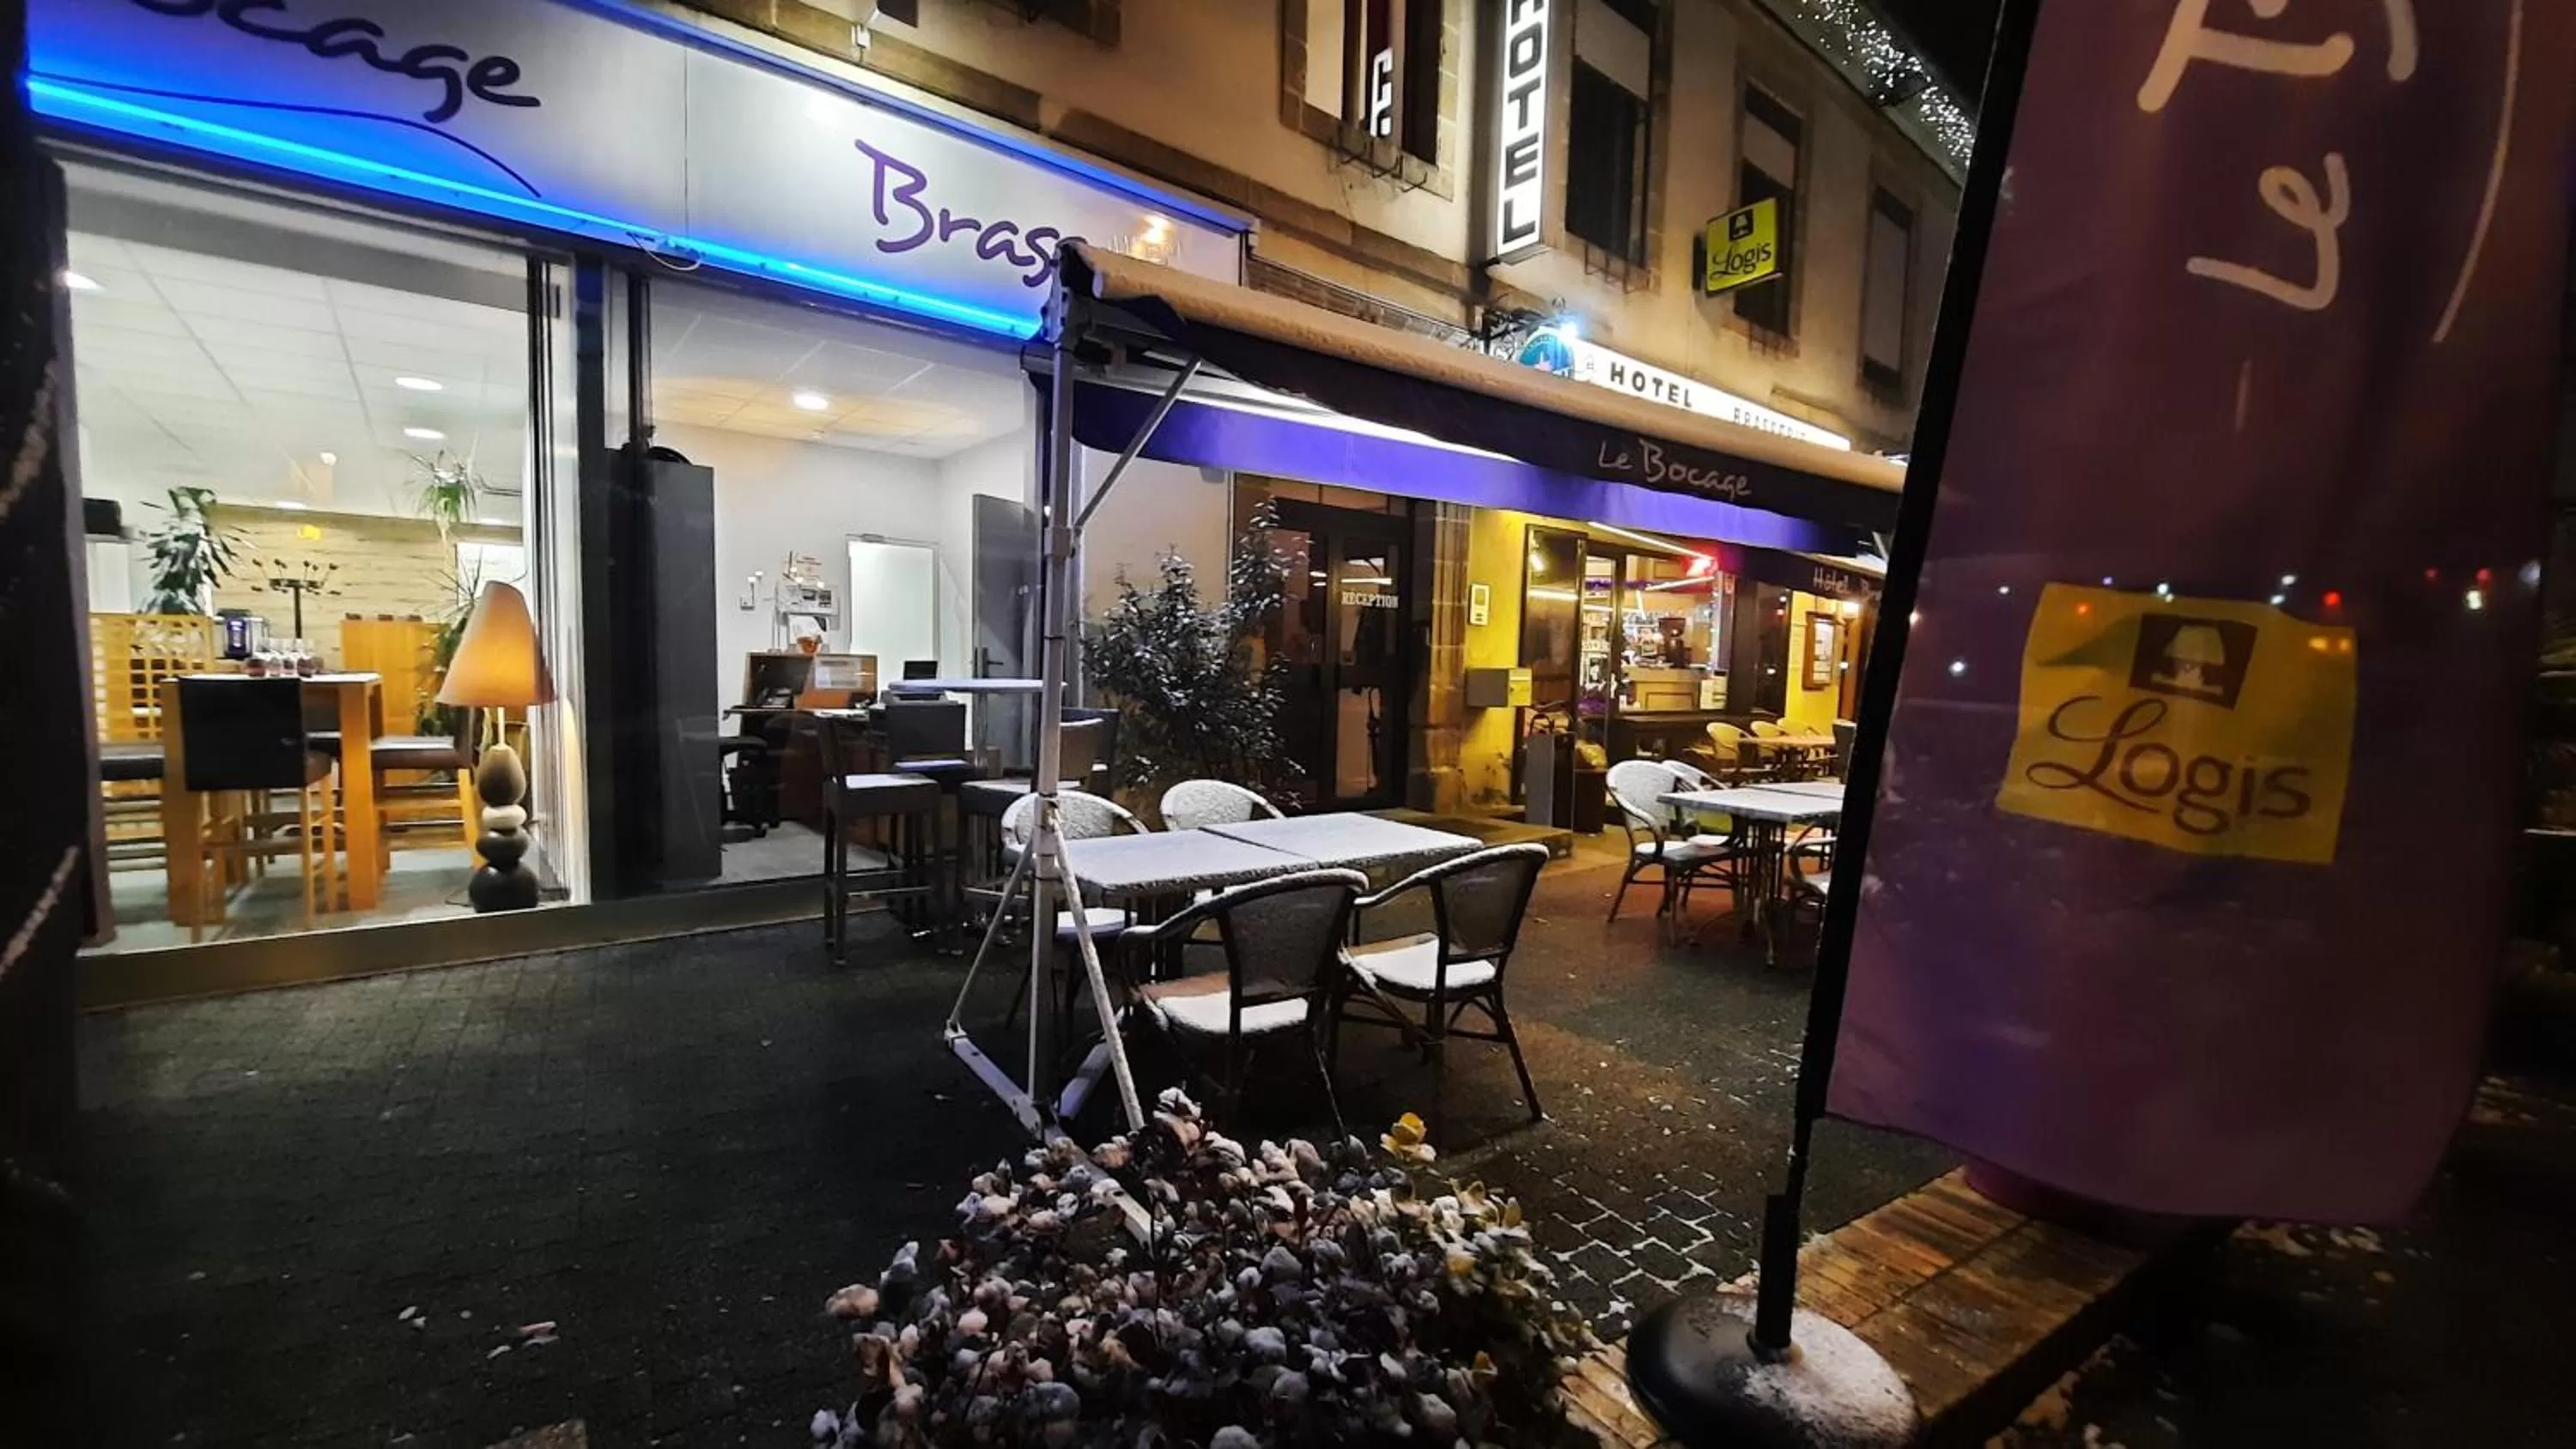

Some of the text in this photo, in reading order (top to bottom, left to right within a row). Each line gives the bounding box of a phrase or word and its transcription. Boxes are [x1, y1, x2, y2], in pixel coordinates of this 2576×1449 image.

[129, 0, 540, 123] cage
[854, 138, 1087, 288] Bras
[1710, 243, 1773, 282] Logis
[2186, 153, 2350, 310] Le
[1610, 361, 1692, 408] HOTEL
[1598, 439, 1752, 501] Le Bocage
[2026, 696, 2312, 835] Logis
